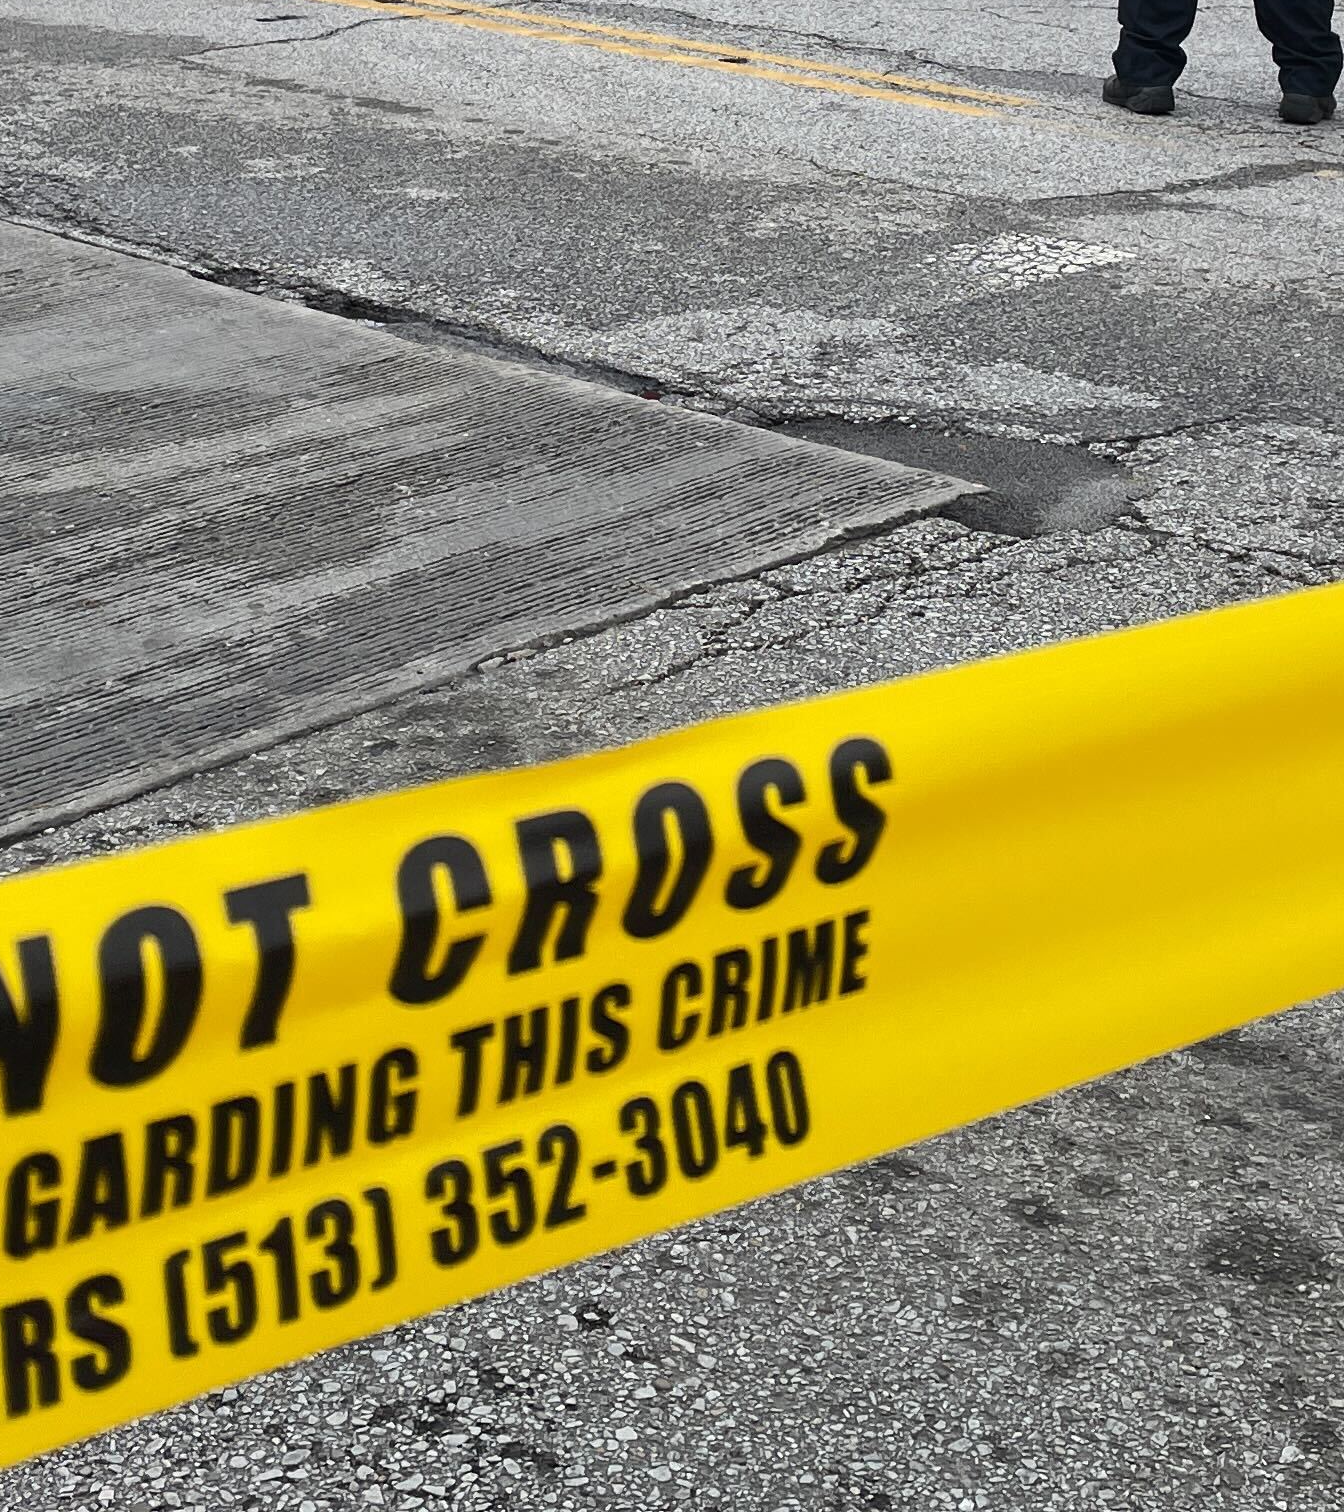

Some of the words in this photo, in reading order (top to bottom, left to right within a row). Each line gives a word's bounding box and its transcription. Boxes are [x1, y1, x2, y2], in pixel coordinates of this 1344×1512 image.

[386, 735, 895, 1007] CROSS
[447, 980, 633, 1119] THIS
[656, 908, 872, 1054] CRIME
[162, 1185, 399, 1361] (513)
[423, 1049, 813, 1270] 352-3040
